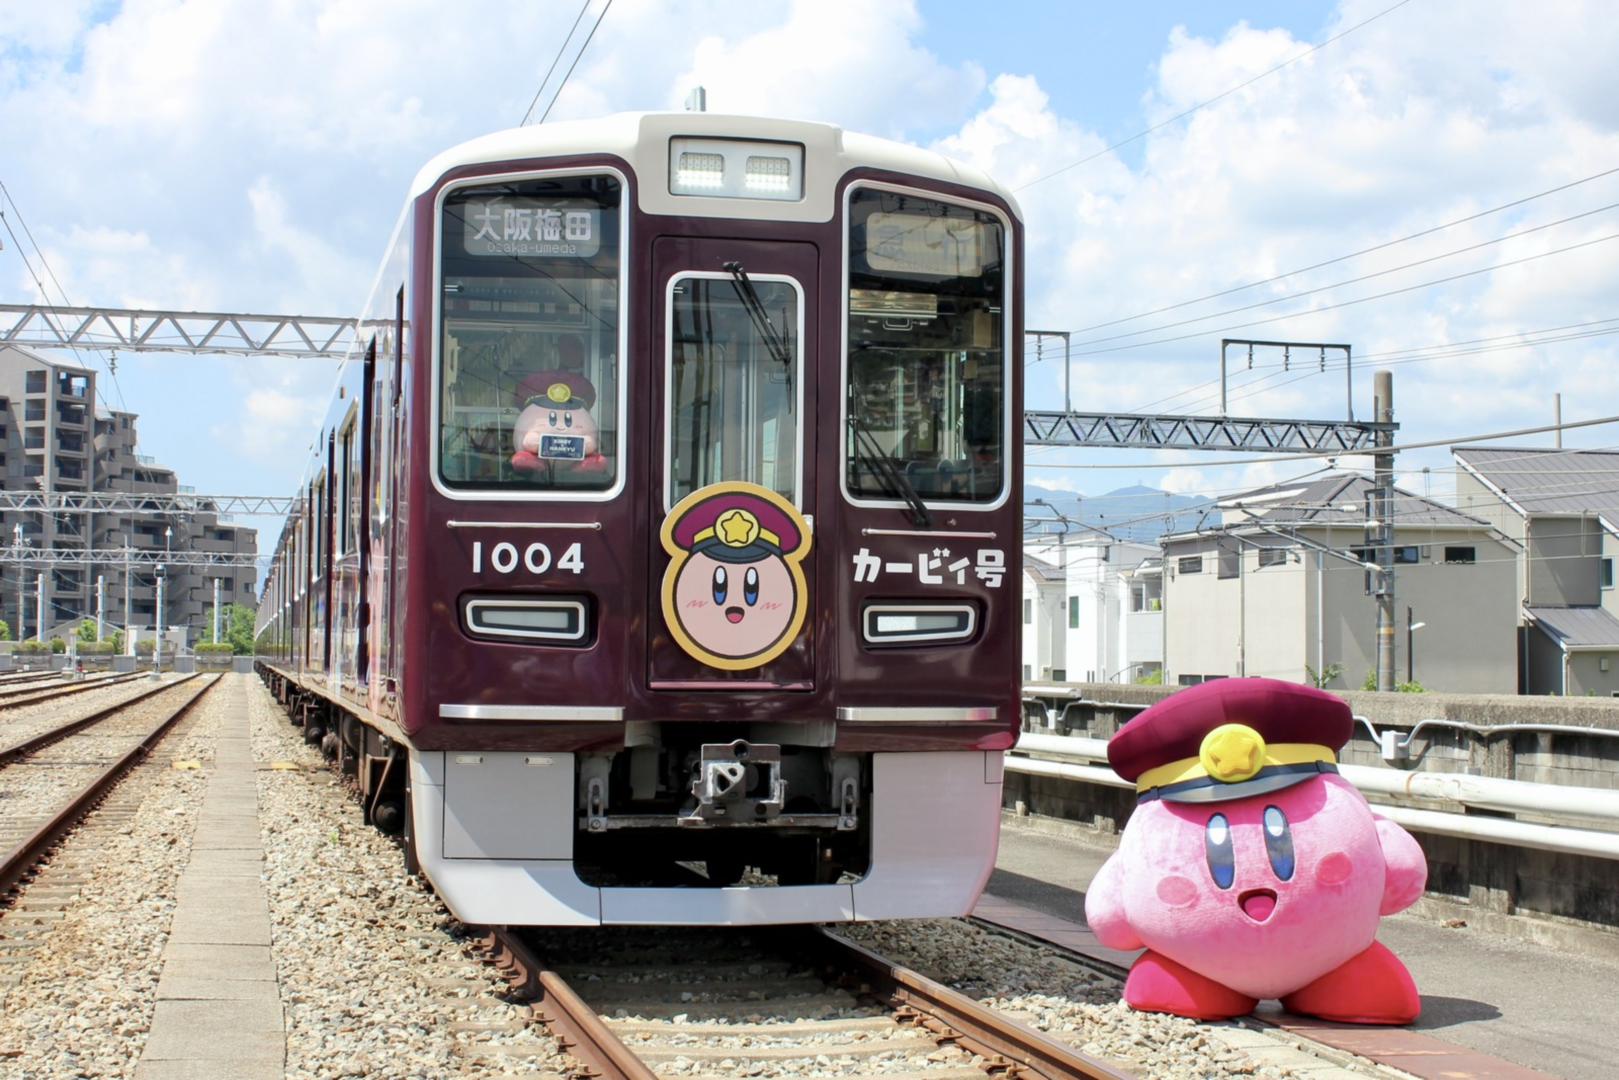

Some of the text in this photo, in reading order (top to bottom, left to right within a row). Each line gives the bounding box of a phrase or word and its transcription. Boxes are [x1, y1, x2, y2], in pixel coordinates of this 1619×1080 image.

[474, 207, 592, 241] 大阪梅田
[487, 242, 576, 254] Osaka-umeda
[472, 541, 585, 575] 1004
[852, 547, 1007, 588] カービィ号
